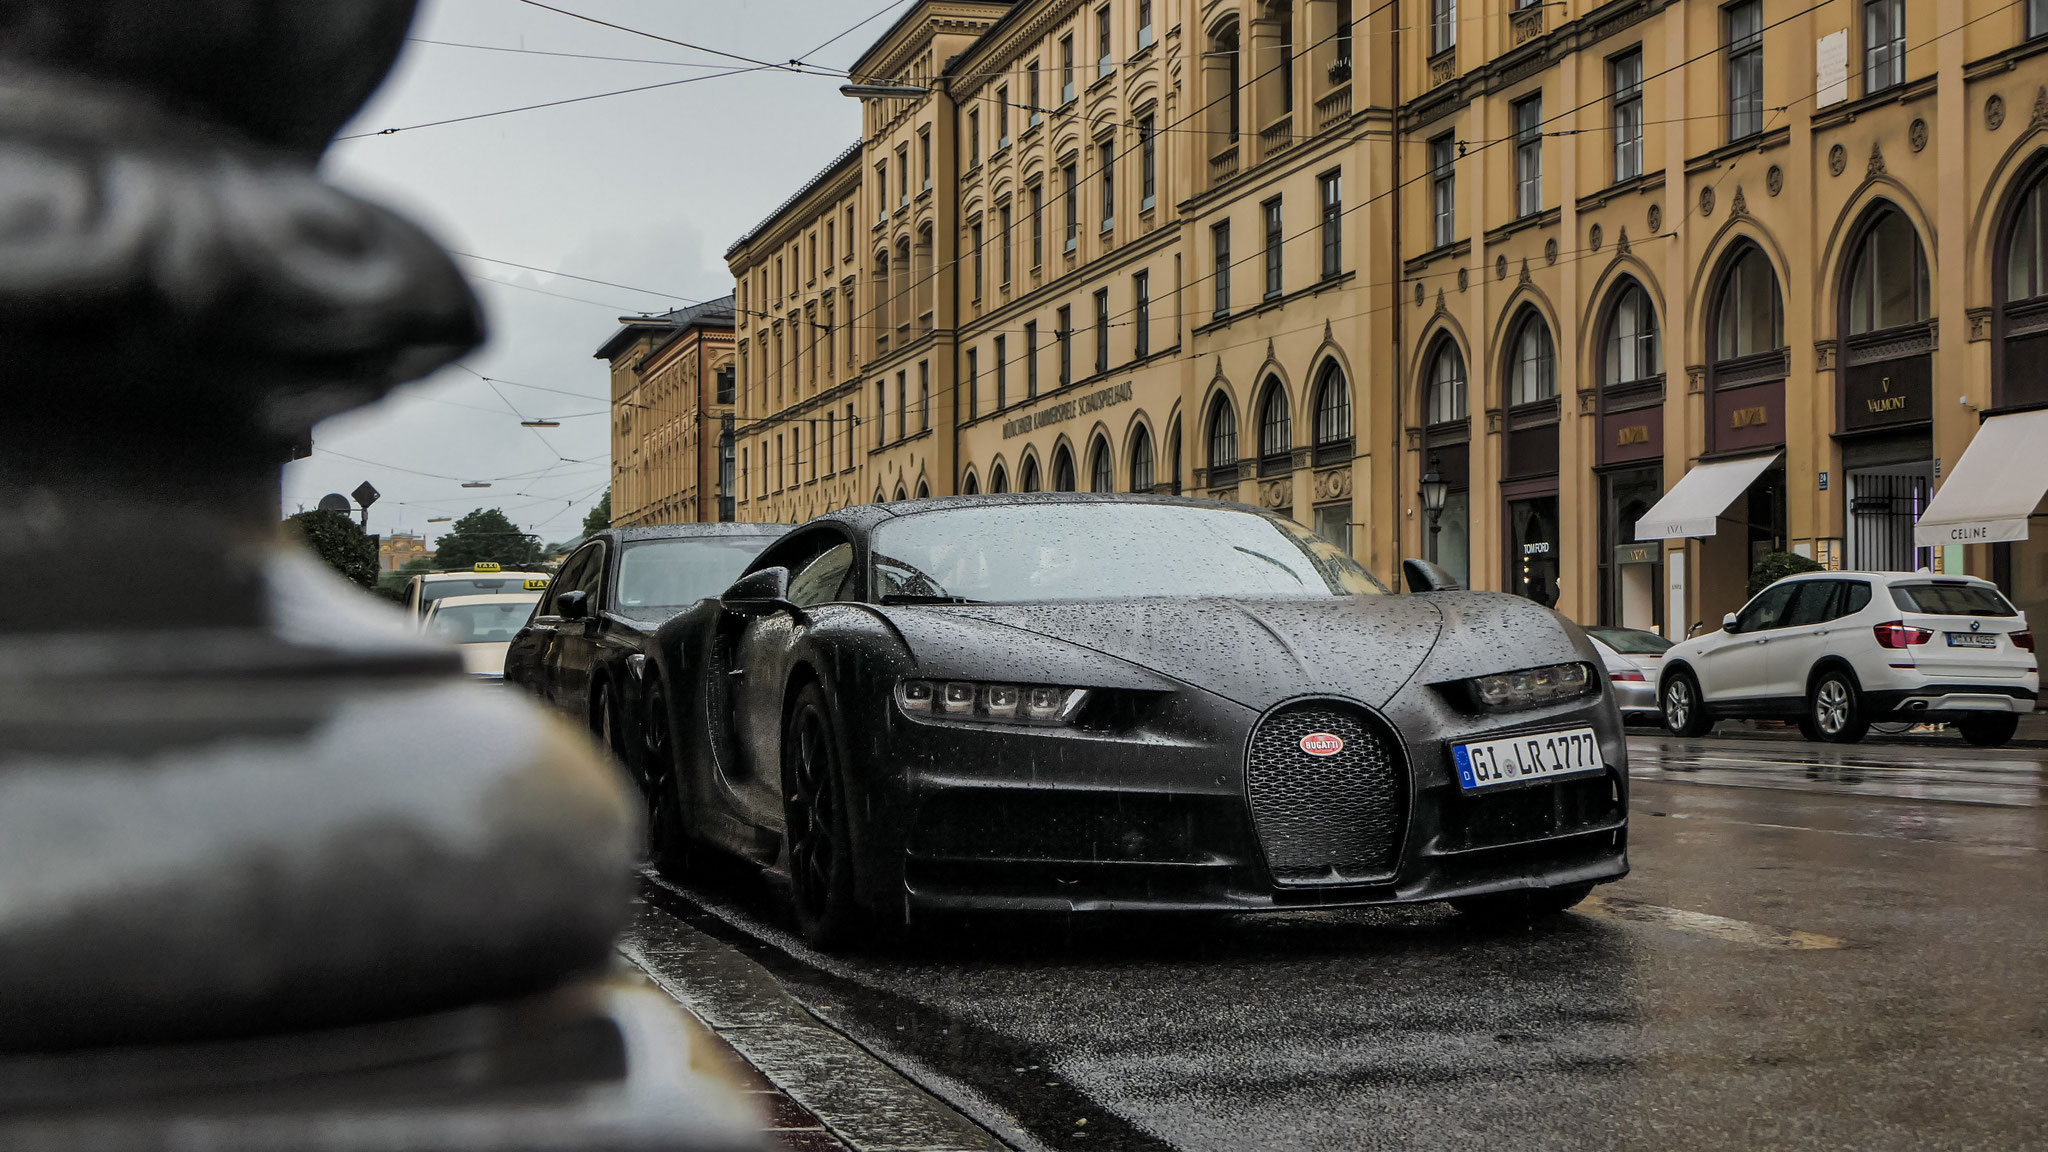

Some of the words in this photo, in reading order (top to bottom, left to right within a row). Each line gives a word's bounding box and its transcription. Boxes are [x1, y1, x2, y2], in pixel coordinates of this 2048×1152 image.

[1867, 396, 1906, 412] VALMONT
[1951, 527, 1987, 540] CELINE
[1524, 543, 1535, 555] TOM
[1535, 542, 1550, 553] FORD
[1305, 741, 1338, 750] BUGATTI
[1471, 746, 1502, 781] GI
[1513, 740, 1546, 775] LR
[1546, 733, 1595, 771] 1777
[1463, 770, 1470, 781] D
